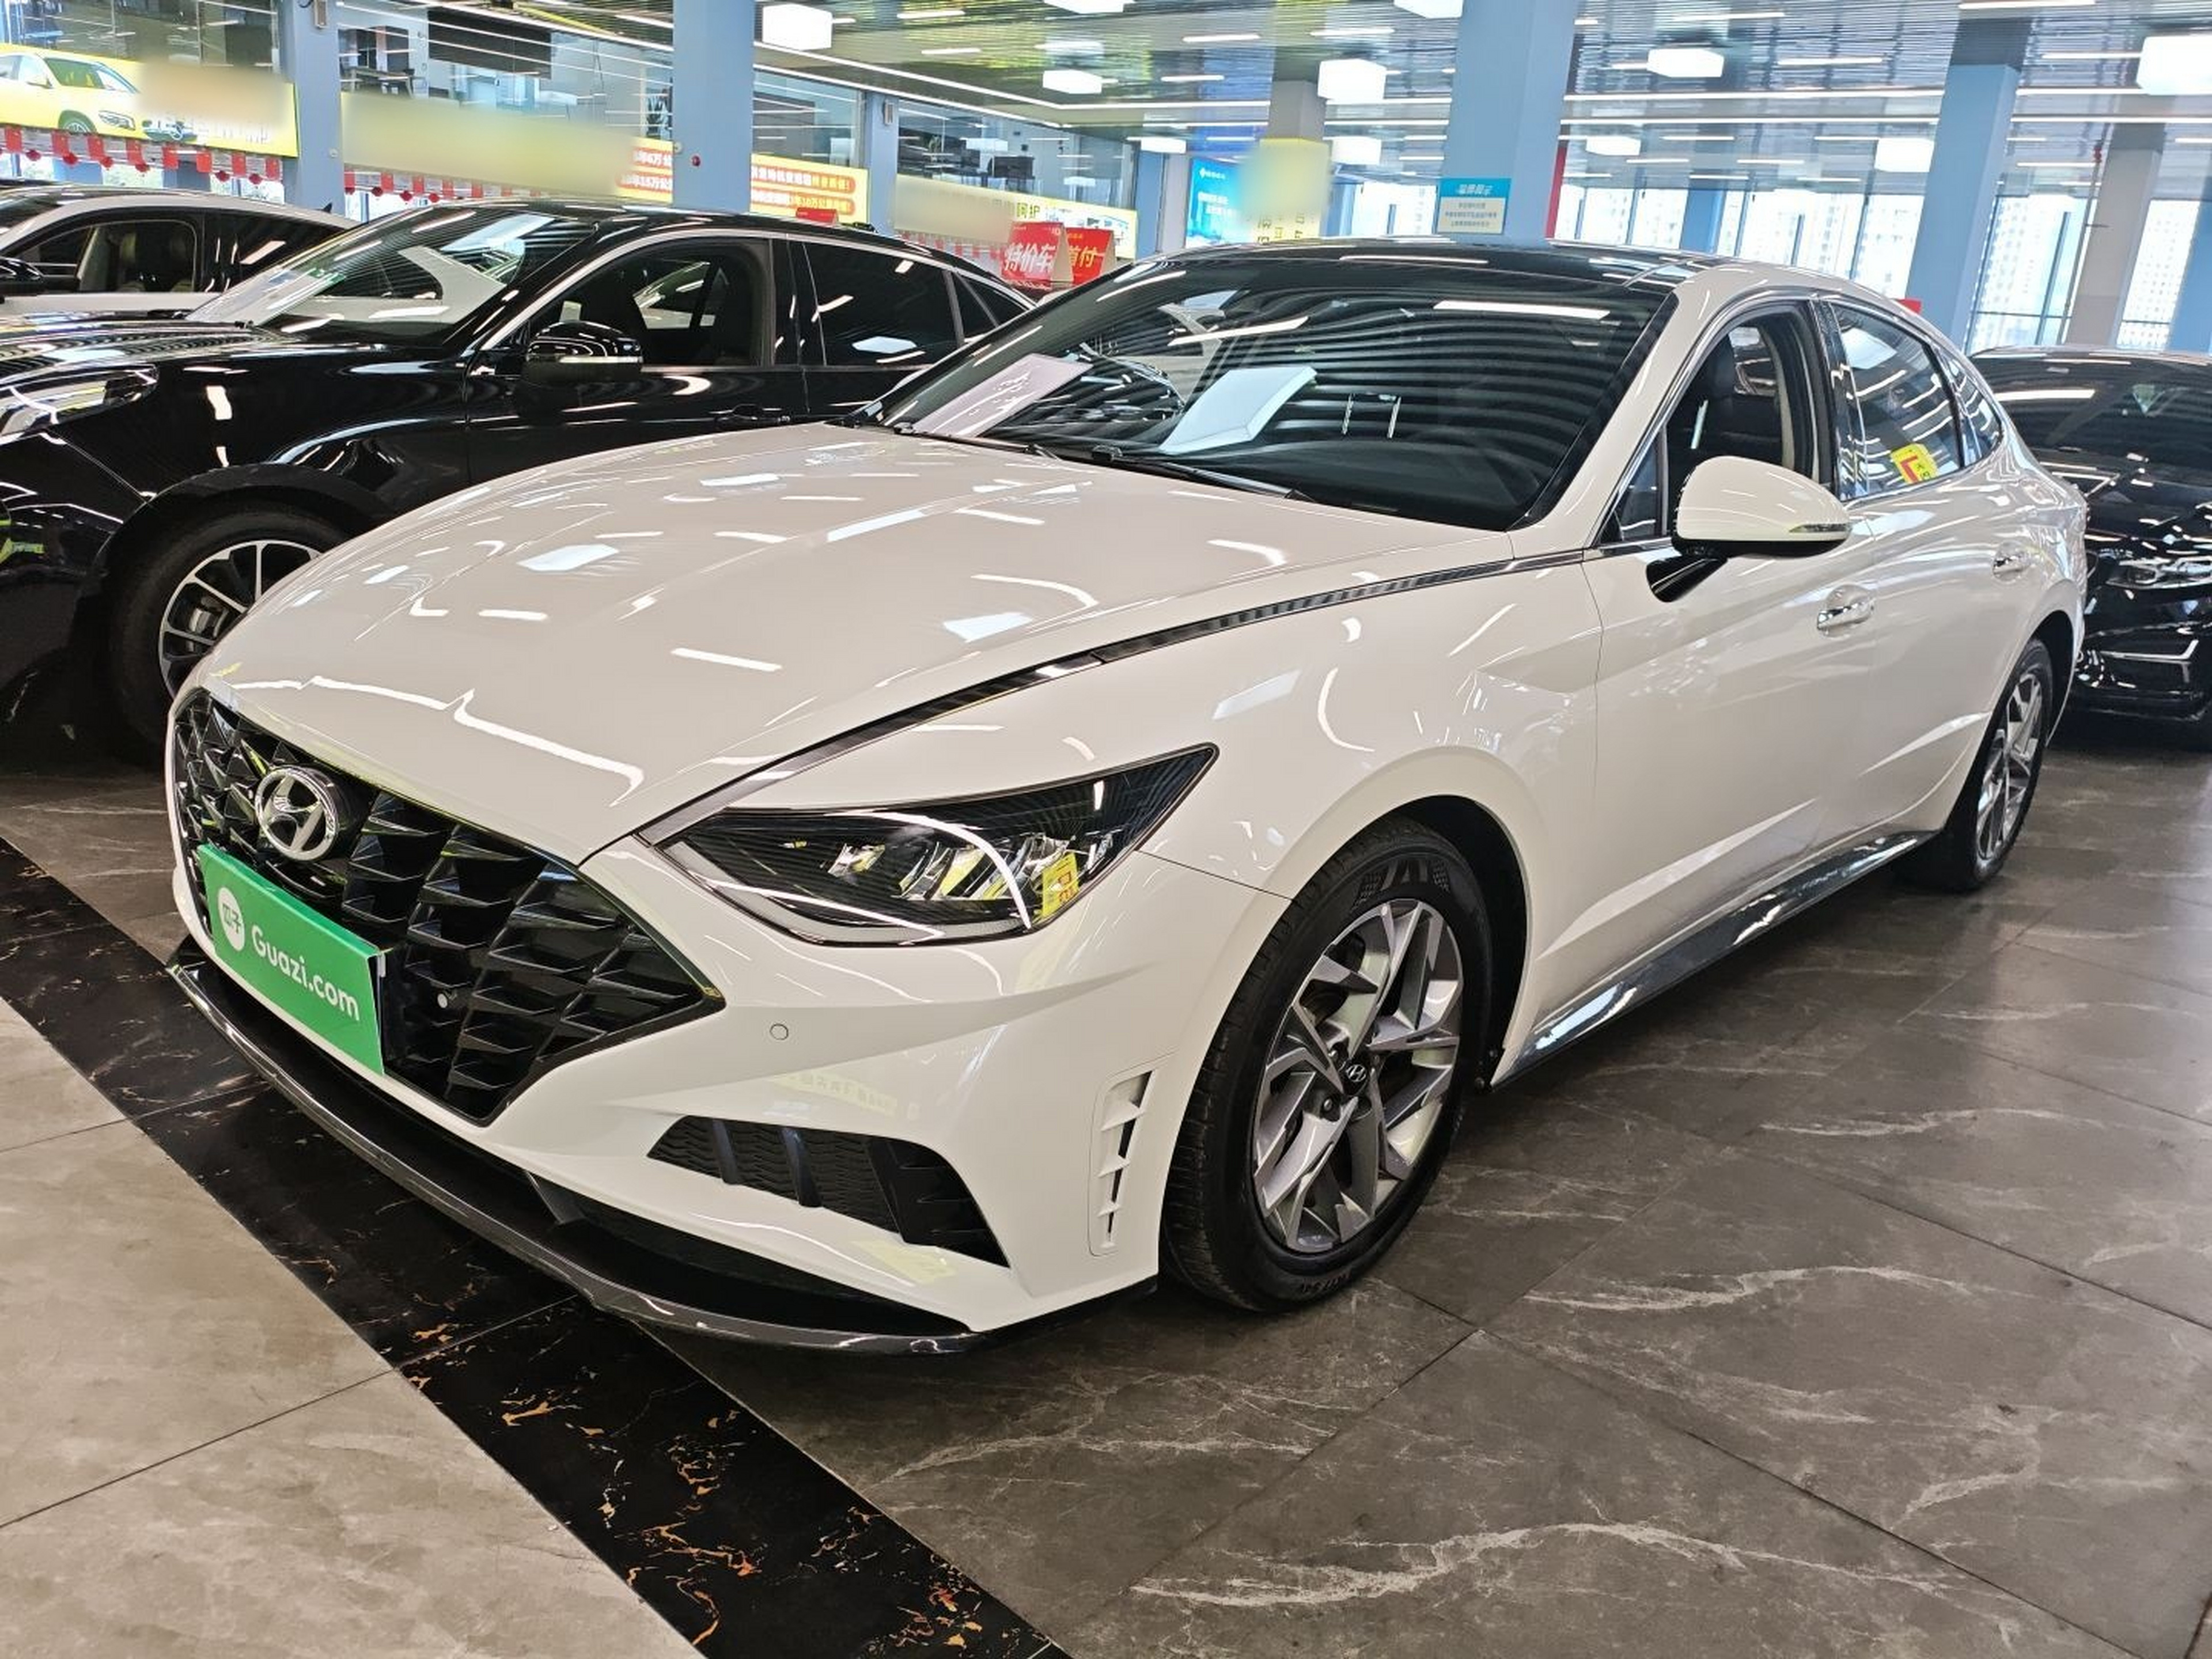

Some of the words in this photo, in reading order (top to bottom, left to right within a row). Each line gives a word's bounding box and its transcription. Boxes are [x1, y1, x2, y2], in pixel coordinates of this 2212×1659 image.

[1005, 243, 1056, 273] 特价车
[252, 925, 360, 1021] Guazi.com
